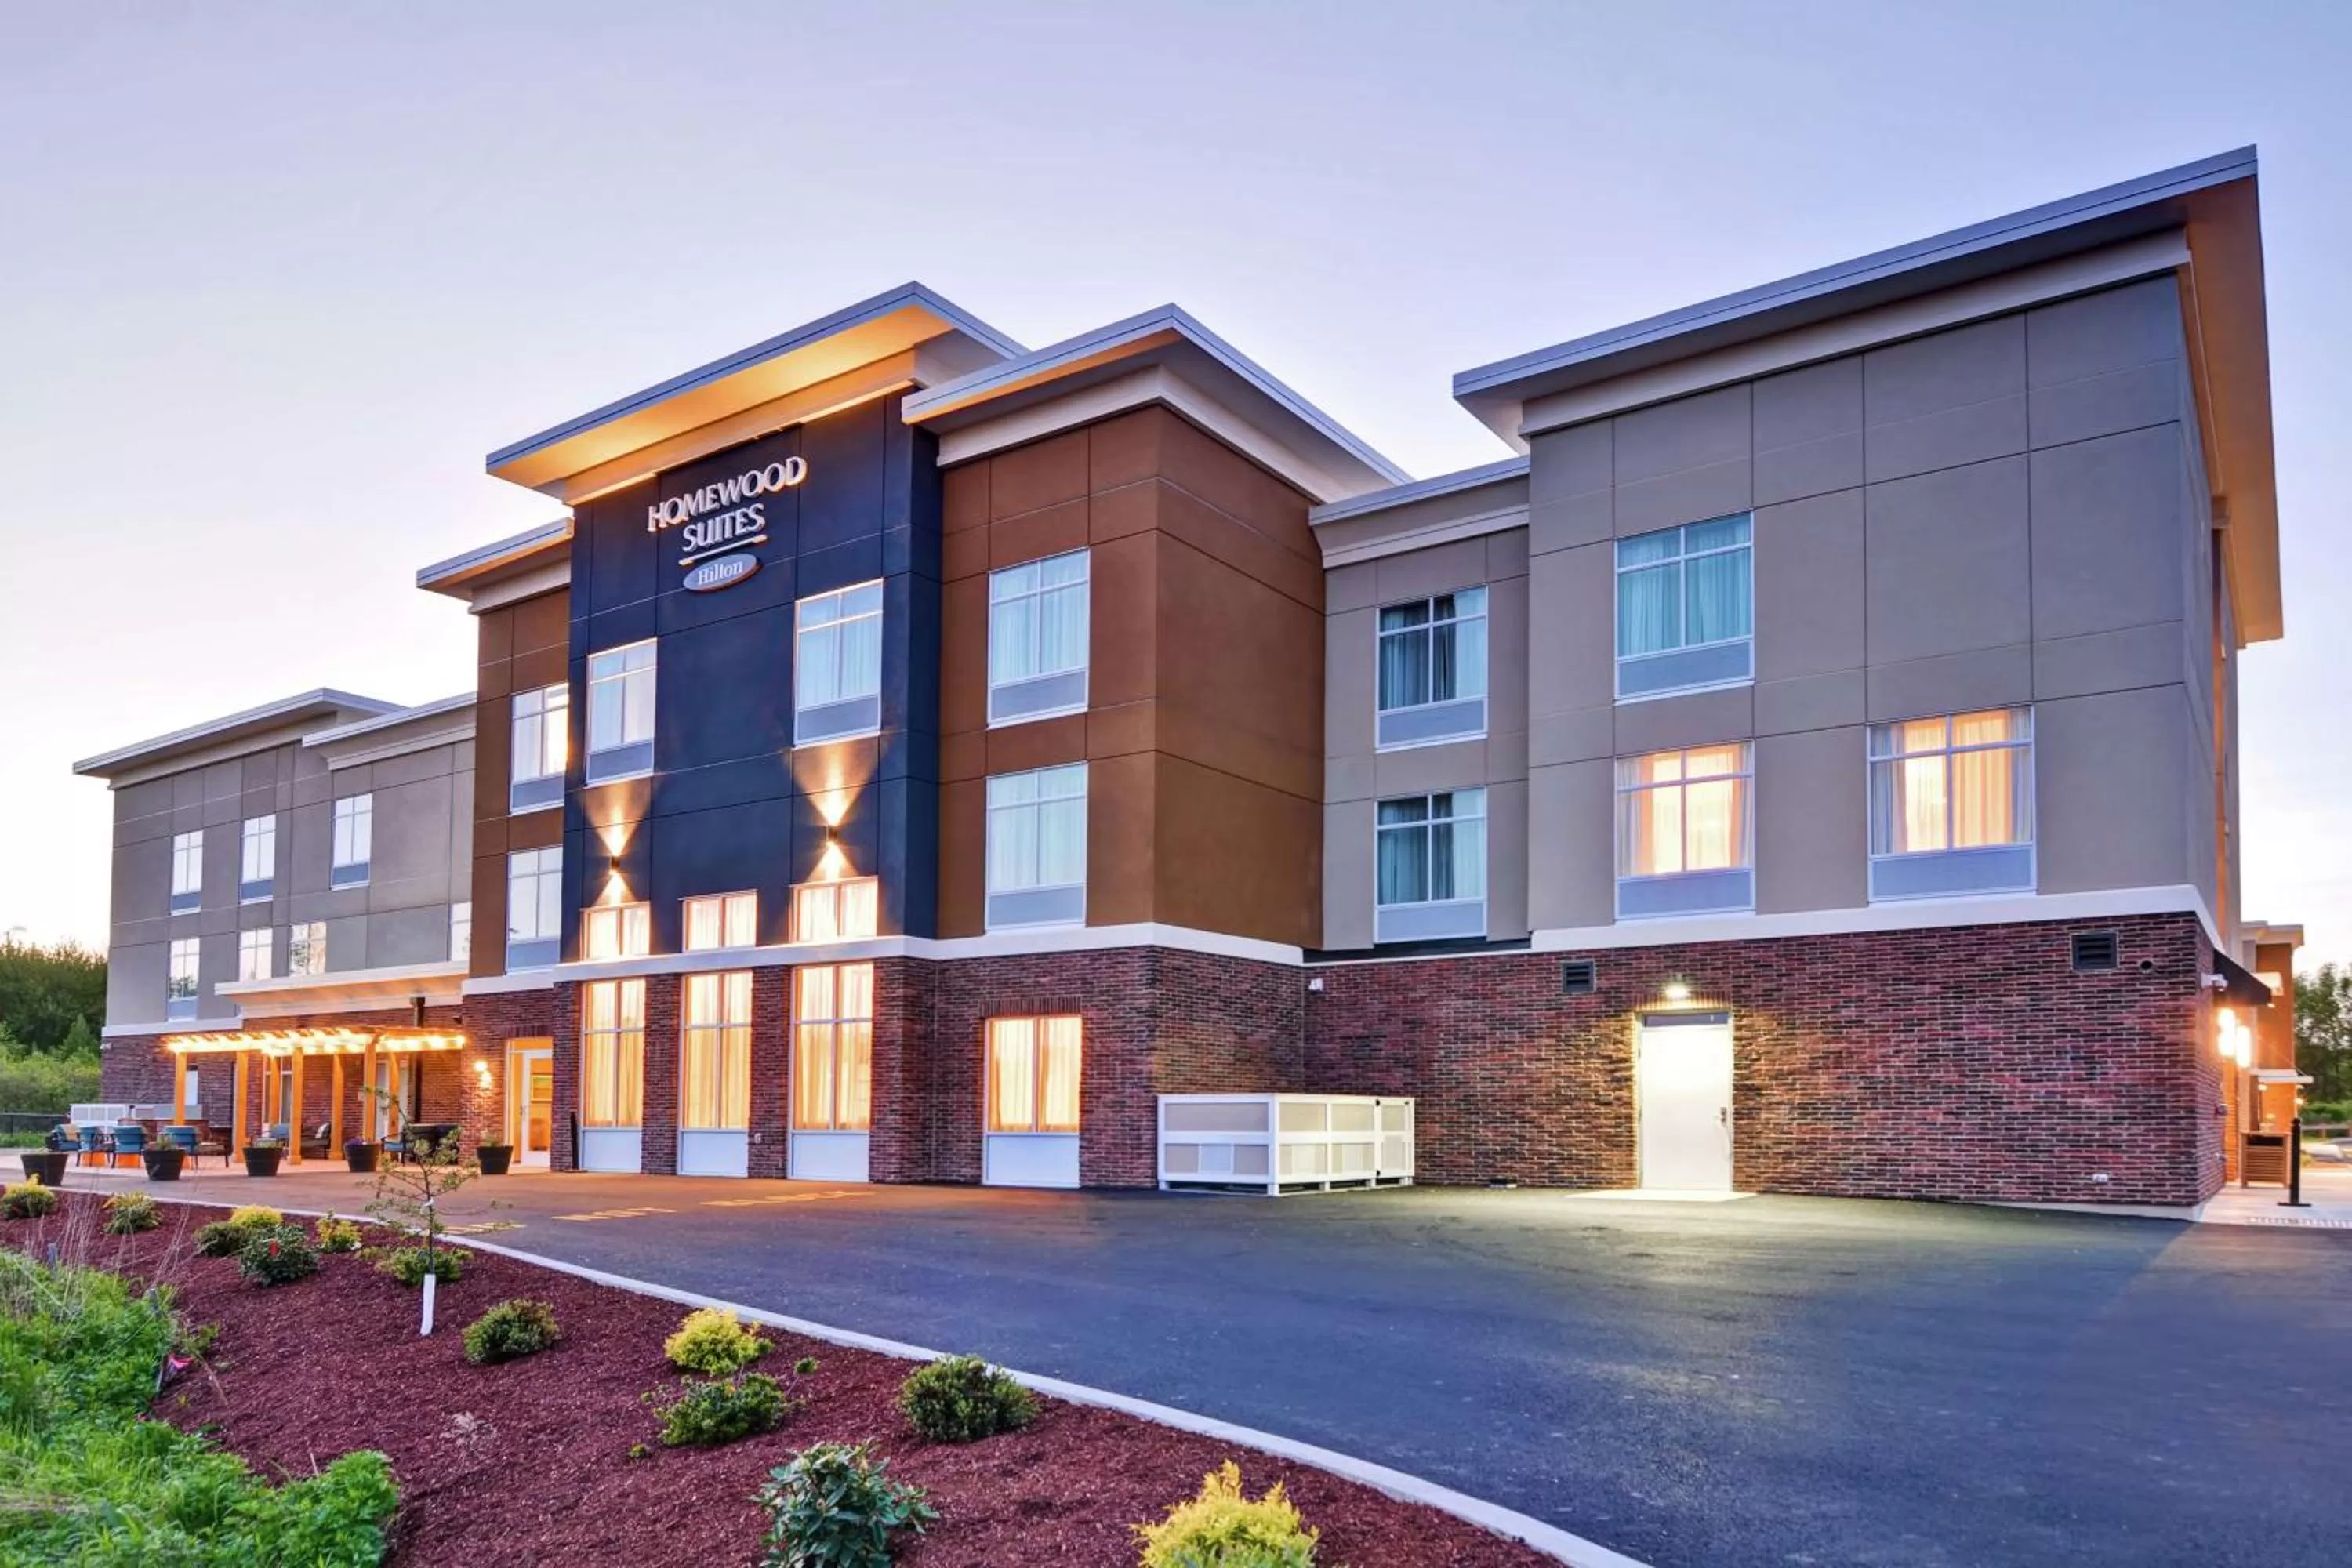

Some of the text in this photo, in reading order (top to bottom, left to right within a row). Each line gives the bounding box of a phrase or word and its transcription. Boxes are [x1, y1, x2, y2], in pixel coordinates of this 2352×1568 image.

[647, 456, 808, 532] HOMEWOOD
[682, 503, 765, 552] SUITES
[698, 561, 743, 586] Hilton
